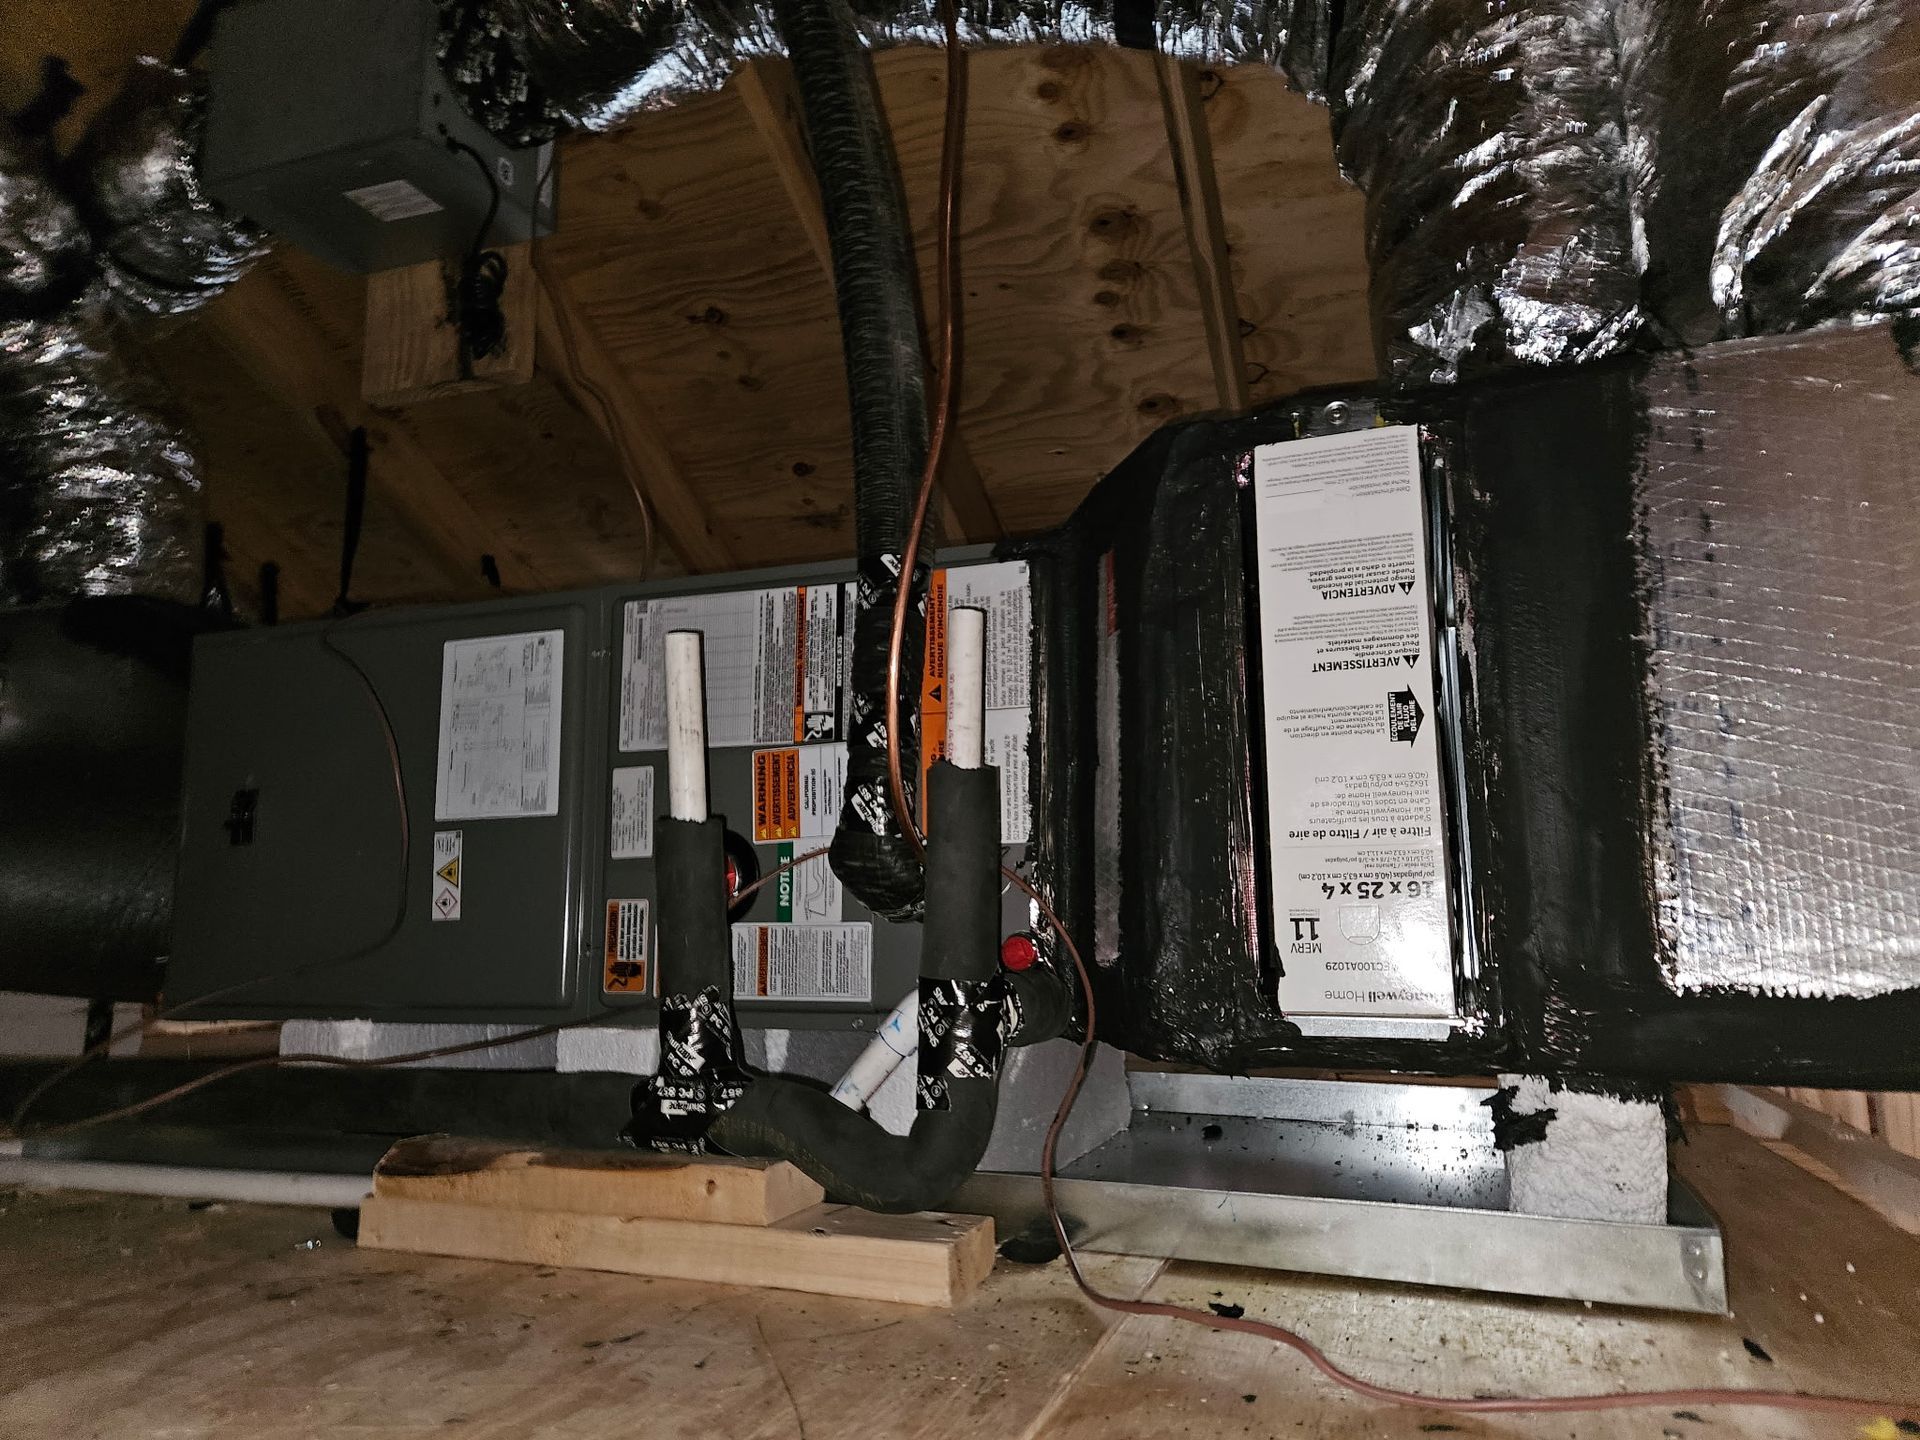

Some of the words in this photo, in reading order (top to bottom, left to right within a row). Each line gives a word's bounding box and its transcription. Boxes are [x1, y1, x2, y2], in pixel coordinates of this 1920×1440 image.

[1388, 560, 1415, 568] muerte
[1392, 567, 1415, 575] Puede
[1354, 577, 1389, 586] potencial
[1390, 574, 1415, 582] Riesgo
[1312, 582, 1343, 590] incendio
[1322, 584, 1396, 600] ADVERTENCIA
[1363, 634, 1405, 643] dommages
[1376, 641, 1400, 649] causer
[1312, 656, 1400, 672] AVERTISSEMENT
[1397, 720, 1404, 730] DE
[757, 755, 766, 826] WARNING
[771, 753, 781, 825] AVERTISSEMENT
[786, 754, 796, 820] ADVERTENCIA
[1289, 831, 1310, 840] aire
[1313, 830, 1326, 840] de
[1329, 829, 1360, 839] Filtro
[1363, 828, 1369, 839] /
[1372, 828, 1387, 838] air
[1390, 828, 1397, 838] à
[1400, 827, 1431, 837] Filtre
[1321, 882, 1335, 900] 4
[1339, 882, 1352, 895] x
[1357, 882, 1384, 899] 25
[1389, 881, 1401, 894] x
[1290, 918, 1320, 941] 11
[1291, 943, 1321, 954] MERV
[1324, 990, 1364, 1002] Home
